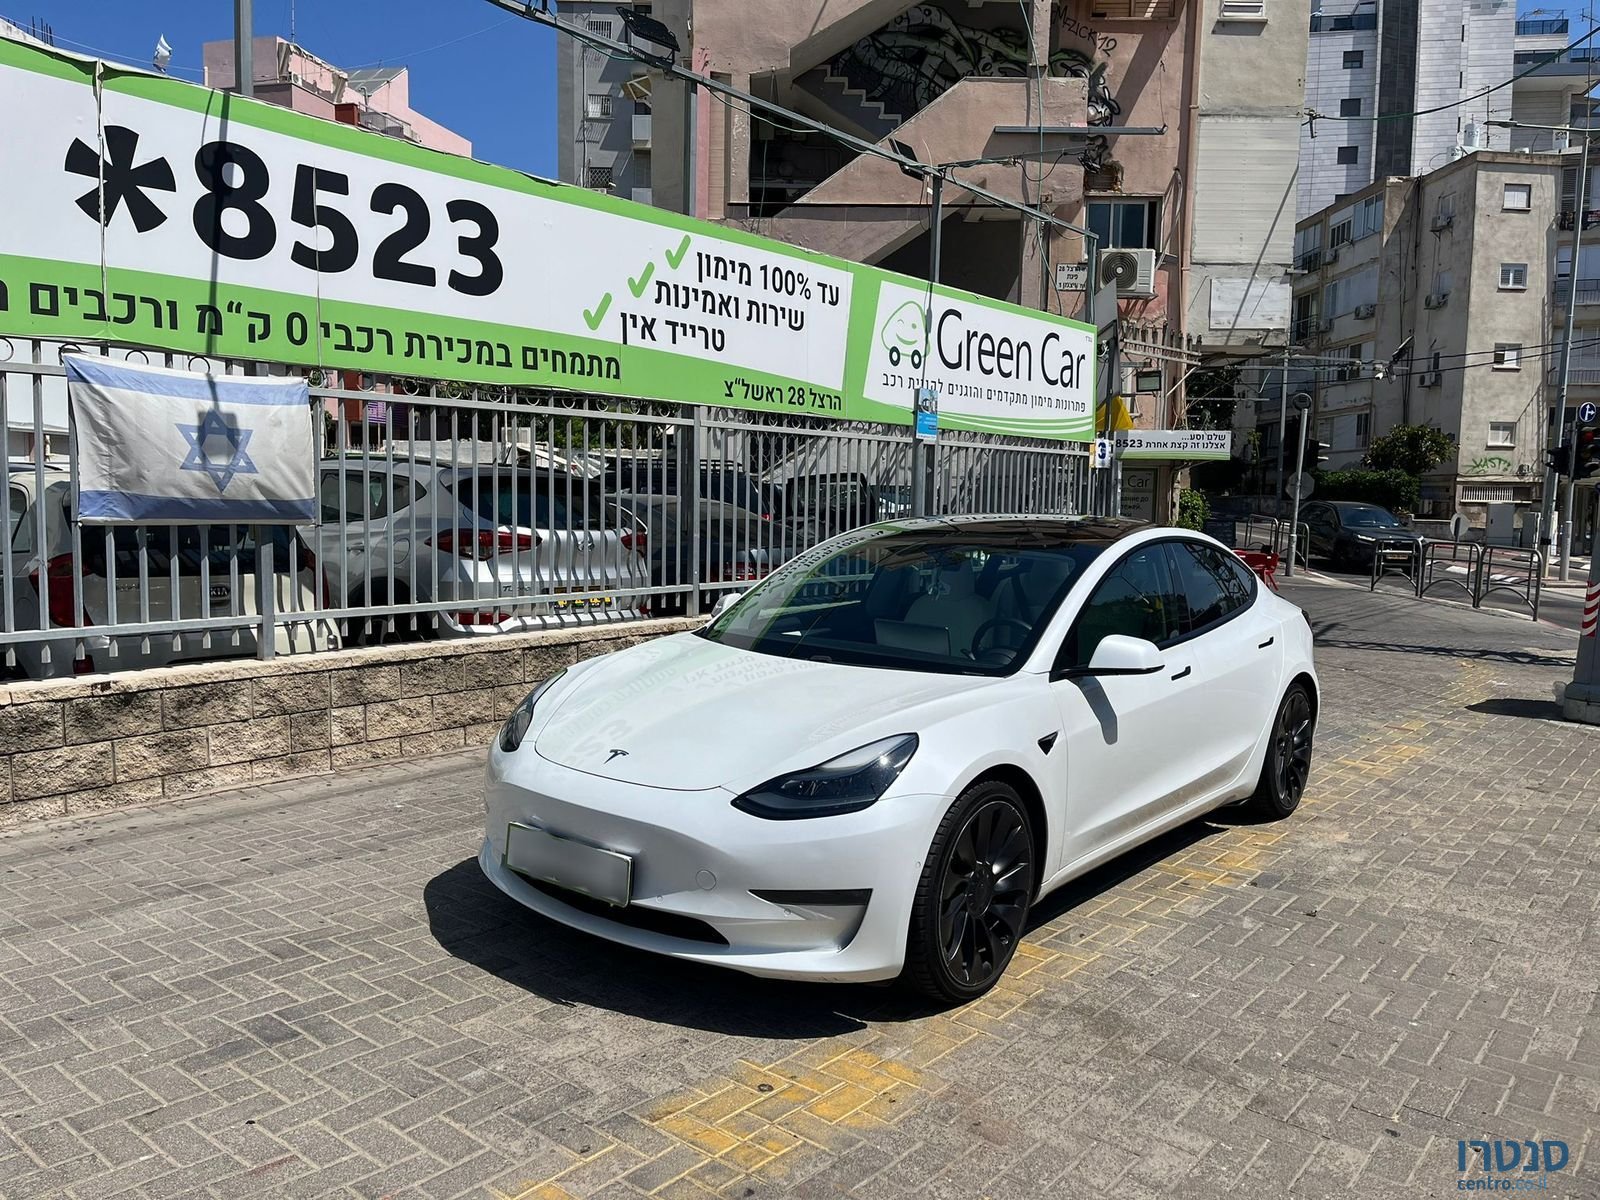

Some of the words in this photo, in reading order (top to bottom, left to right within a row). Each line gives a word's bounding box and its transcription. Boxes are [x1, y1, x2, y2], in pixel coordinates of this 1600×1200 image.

[697, 252, 751, 287] מימון
[760, 264, 811, 300] 100%
[655, 280, 739, 319] ואמינות
[817, 281, 839, 306] עד
[30, 282, 178, 330] ורכבים
[747, 299, 804, 331] שירות
[621, 312, 656, 345] אין
[665, 320, 725, 352] טרייד
[320, 322, 393, 356] רכבי
[937, 309, 1031, 381] Green
[1041, 332, 1086, 389] Car
[404, 331, 512, 368] במכירת
[522, 345, 620, 379] מתמחים
[882, 373, 903, 388] רכב
[788, 386, 805, 406] 28
[809, 388, 842, 410] הרצל
[948, 383, 982, 399] והוגנים
[987, 388, 1027, 406] מתקדמים
[1031, 395, 1052, 408] מימון
[1055, 399, 1086, 412] פתרונות
[1115, 439, 1143, 448] 8523
[1145, 441, 1168, 449] אחרת
[1170, 441, 1188, 450] קצת
[1190, 441, 1199, 449] זה
[1202, 441, 1225, 449] אצלנו
[1207, 433, 1226, 441] שלם
[1127, 474, 1150, 488] Car
[210, 587, 228, 596] KIA
